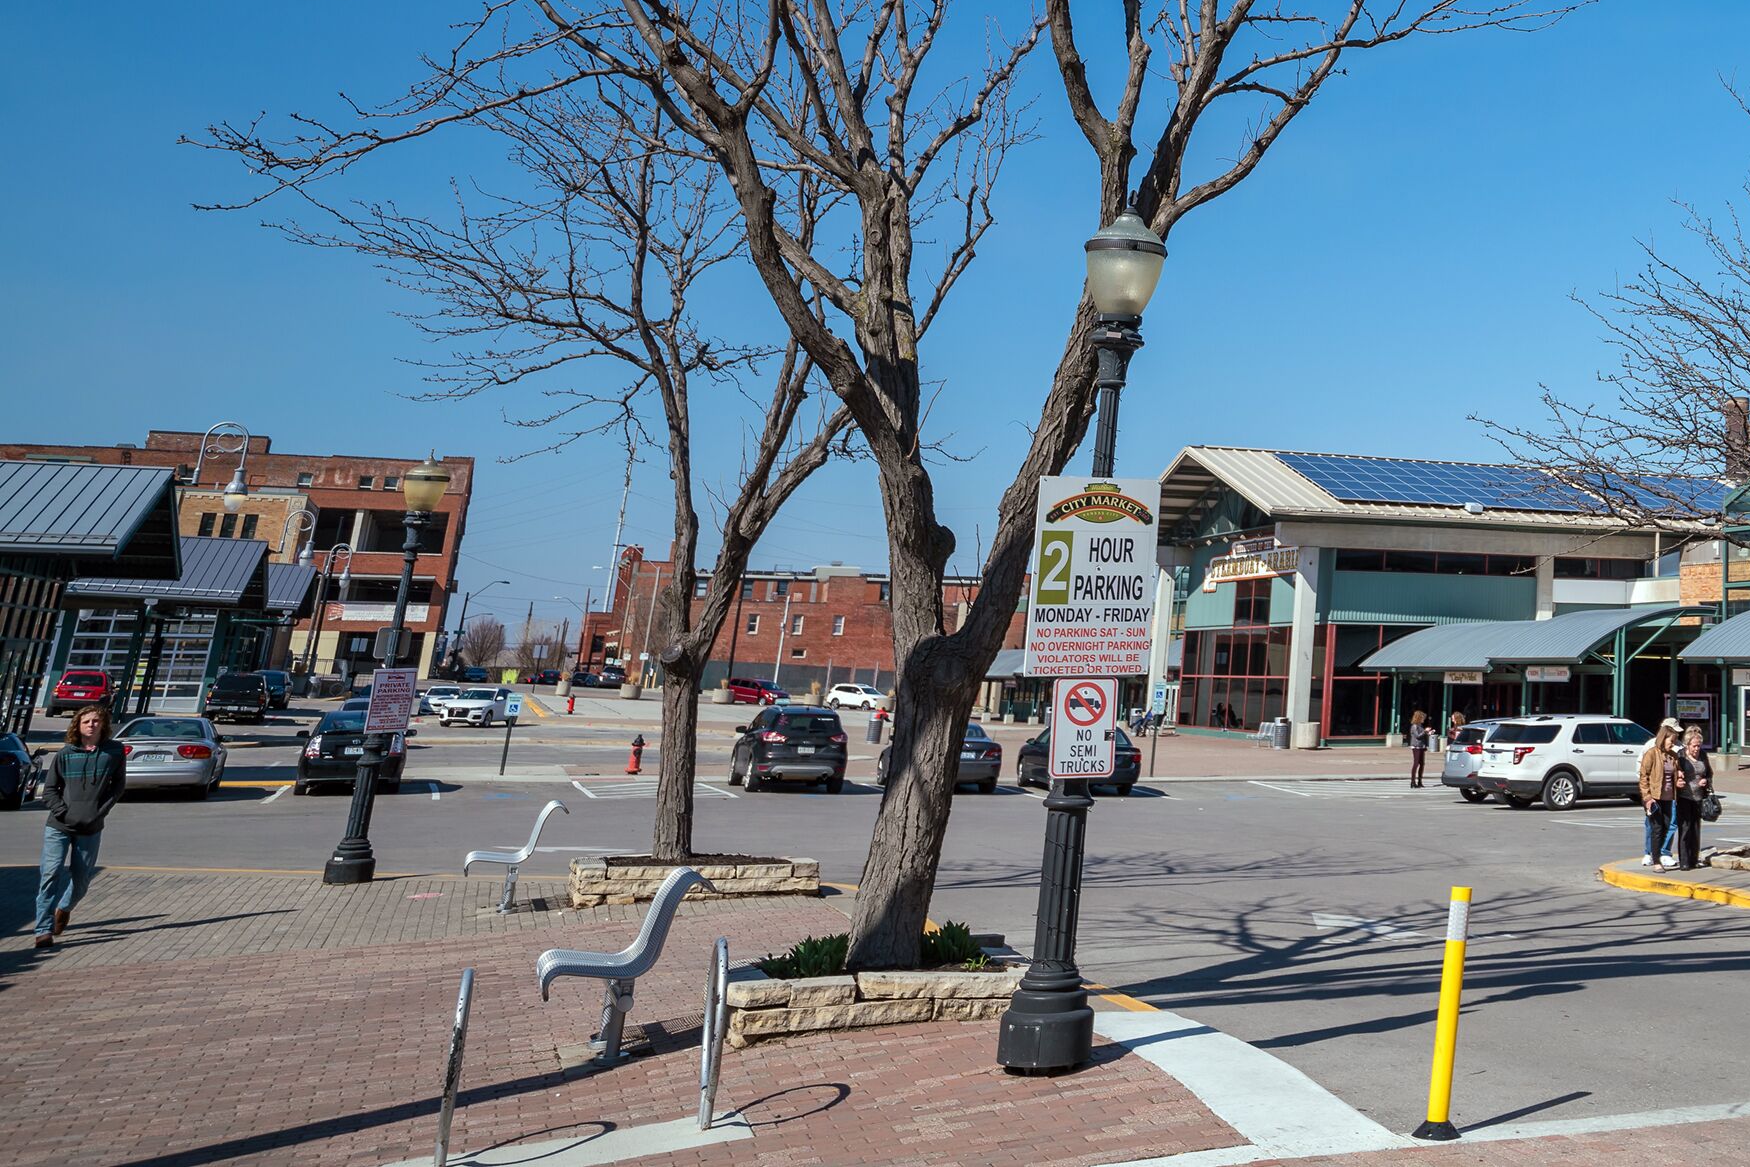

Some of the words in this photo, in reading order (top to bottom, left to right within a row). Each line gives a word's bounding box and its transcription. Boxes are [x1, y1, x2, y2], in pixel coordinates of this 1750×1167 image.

[1061, 497, 1087, 513] CITY
[1091, 495, 1141, 516] MARKET
[1089, 537, 1134, 563] HOUR
[1040, 540, 1070, 590] 2
[1266, 549, 1299, 571] ARABI
[1073, 575, 1143, 600] PARKING
[1035, 608, 1092, 622] MONDAY
[1103, 608, 1150, 622] FRIDAY
[1036, 628, 1051, 638] NO
[1054, 628, 1097, 638] PARKING
[1100, 627, 1118, 637] SAT
[1126, 627, 1146, 637] SUN
[1030, 641, 1045, 651] NO
[1048, 641, 1105, 651] OVERNIGHT
[1107, 640, 1150, 650] PARKING
[1037, 654, 1096, 663] VIOLATORS
[1099, 654, 1122, 662] WILL
[1126, 653, 1140, 662] BE
[1033, 665, 1084, 674] TICKETED
[1087, 665, 1102, 673] OR
[1104, 664, 1142, 673] TOWED
[1076, 729, 1092, 742] NO
[1069, 745, 1097, 757] SEMI
[1060, 760, 1105, 773] TRUCKS
